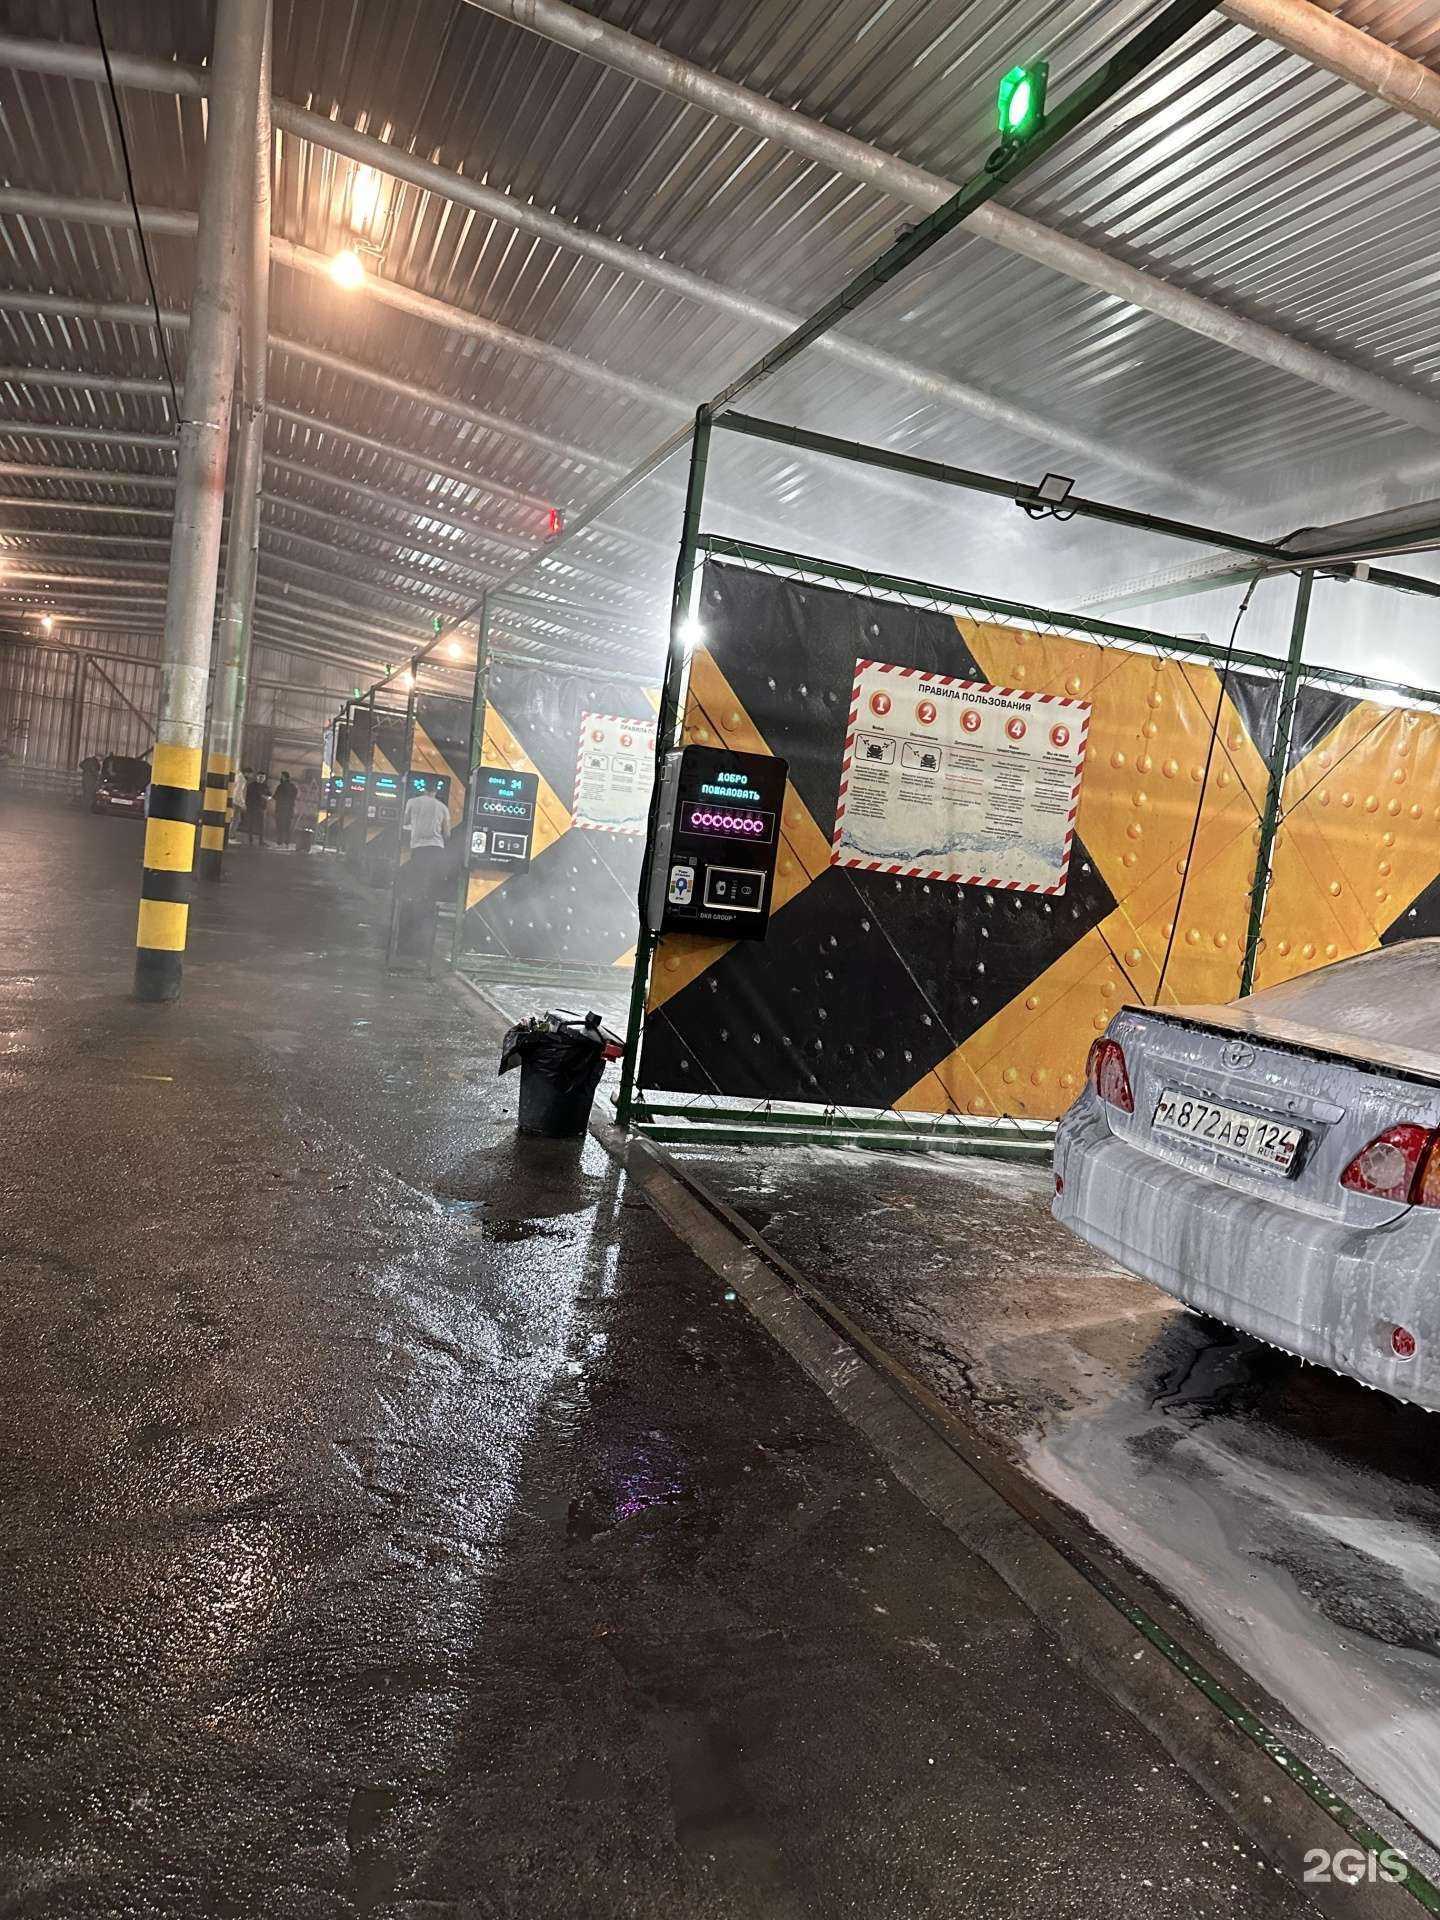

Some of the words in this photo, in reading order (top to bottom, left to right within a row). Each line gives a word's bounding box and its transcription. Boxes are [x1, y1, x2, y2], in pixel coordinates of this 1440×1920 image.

[877, 697, 885, 713] 1
[918, 683, 960, 700] ПРАВИЛА
[961, 692, 1032, 712] ПОЛЬЗОВАНИЯ
[922, 705, 933, 721] 2
[966, 713, 976, 729] 3
[1011, 720, 1022, 736] 4
[1055, 728, 1065, 743] 5
[717, 772, 748, 784] ДОБРО
[701, 784, 760, 800] ПОЖАЛОВАТЬ
